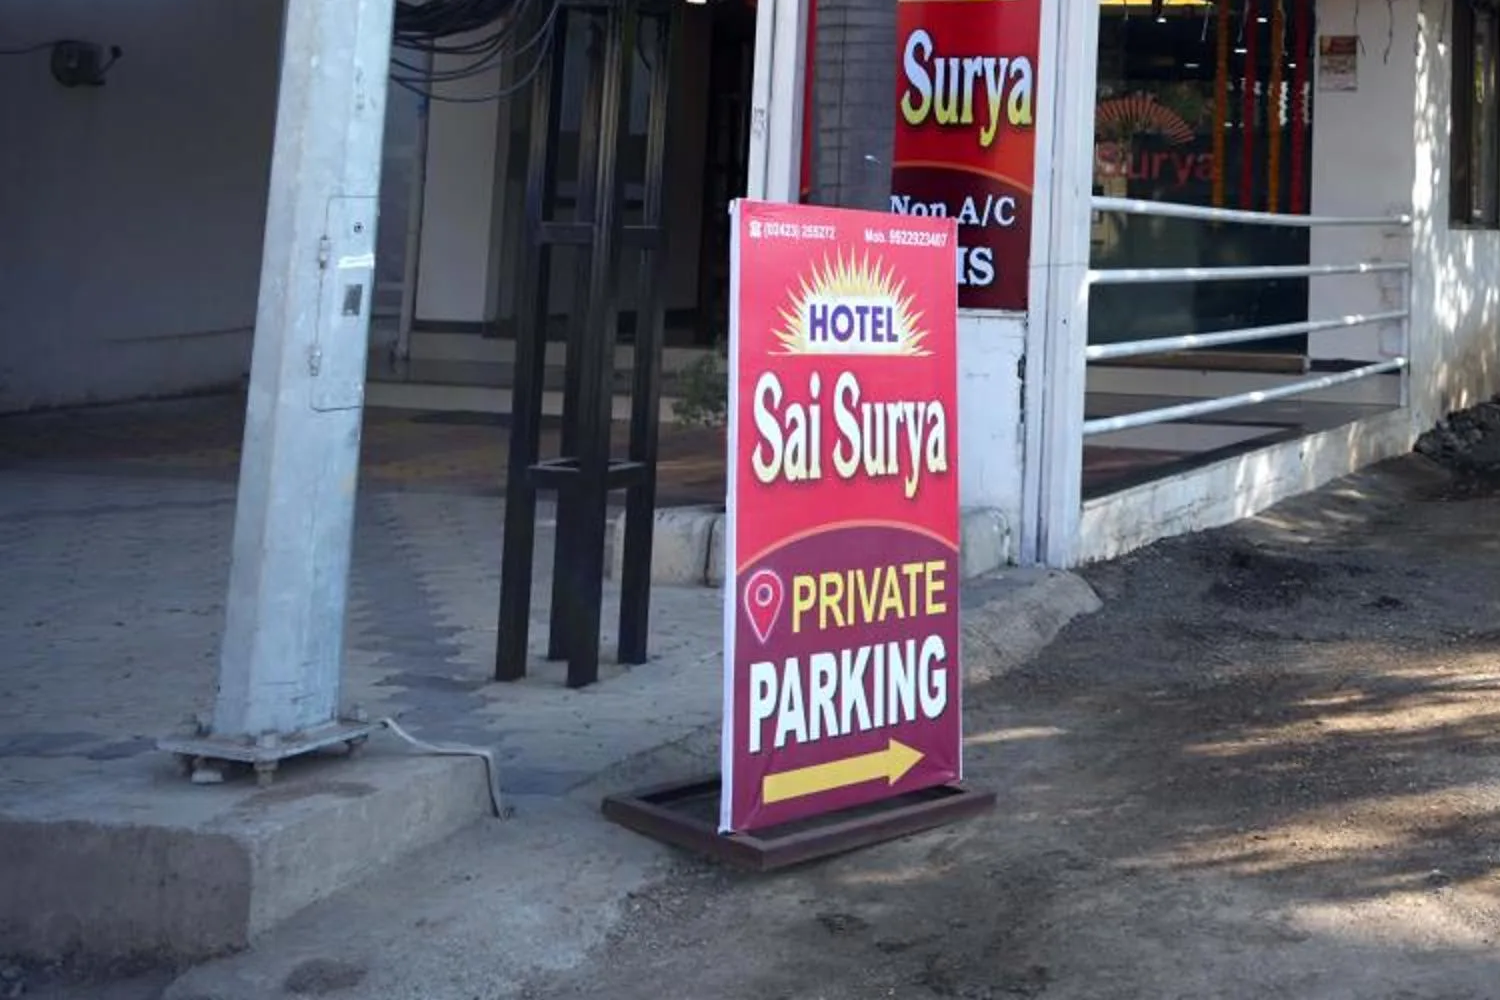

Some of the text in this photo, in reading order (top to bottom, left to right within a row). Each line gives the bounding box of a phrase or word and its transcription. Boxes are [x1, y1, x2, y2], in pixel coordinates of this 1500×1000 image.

[900, 28, 1033, 147] Surya
[956, 195, 1016, 226] A/C
[809, 303, 899, 343] HOTEL
[751, 371, 948, 499] Sai Surya
[792, 560, 946, 634] PRIVATE
[748, 635, 948, 754] PARKING
